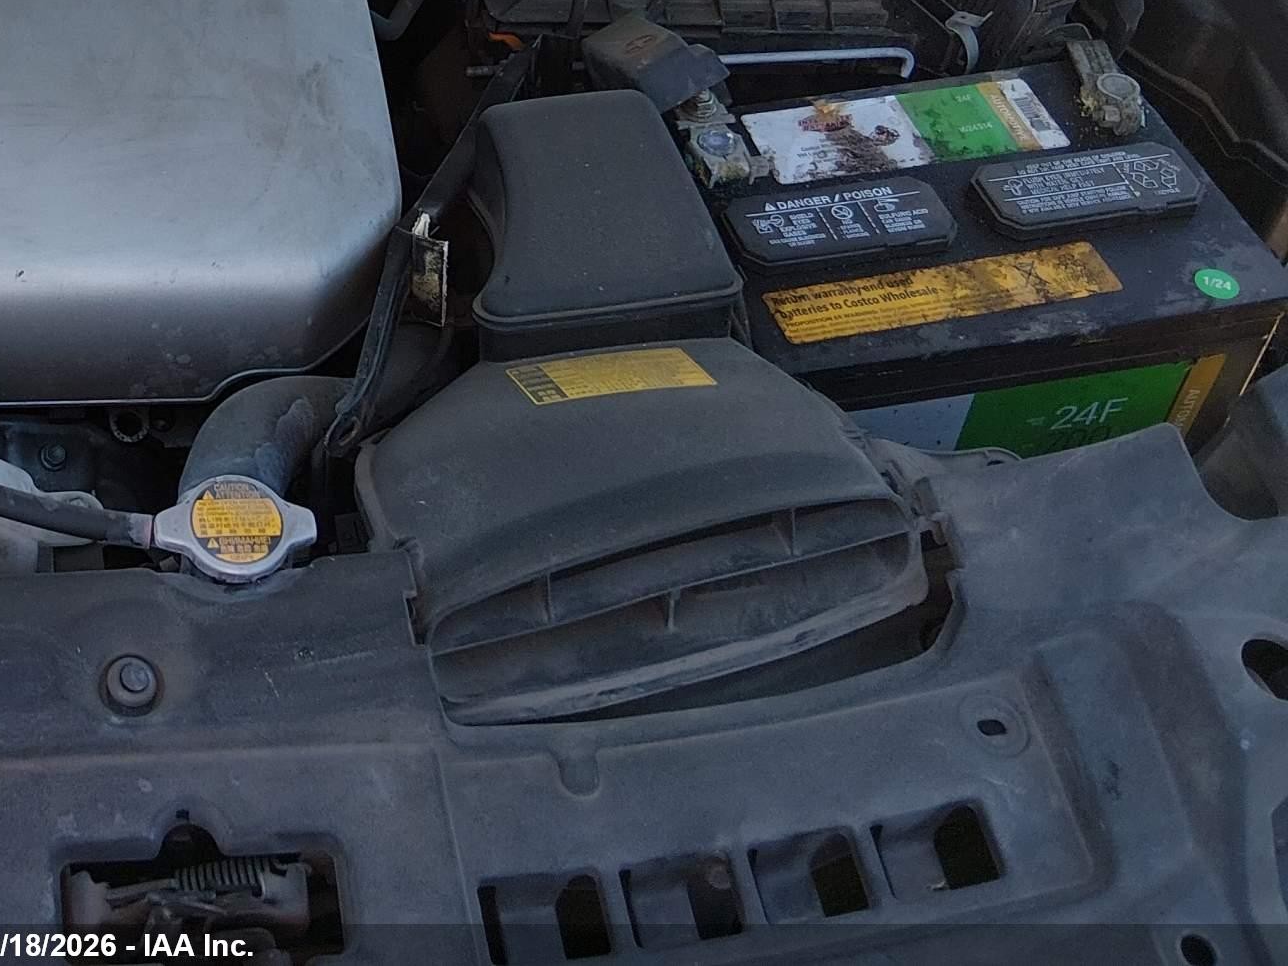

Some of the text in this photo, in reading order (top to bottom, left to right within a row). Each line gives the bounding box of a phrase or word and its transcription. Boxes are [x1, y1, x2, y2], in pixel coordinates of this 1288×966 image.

[776, 186, 894, 211] DANGER / POISON
[772, 292, 811, 307] Return
[812, 285, 863, 301] warranty
[886, 275, 914, 289] used
[1202, 274, 1233, 291] 1/24
[775, 286, 939, 321] batteries to Costco Wholesale
[1050, 396, 1130, 431] 24F
[214, 483, 250, 492] CAUTION
